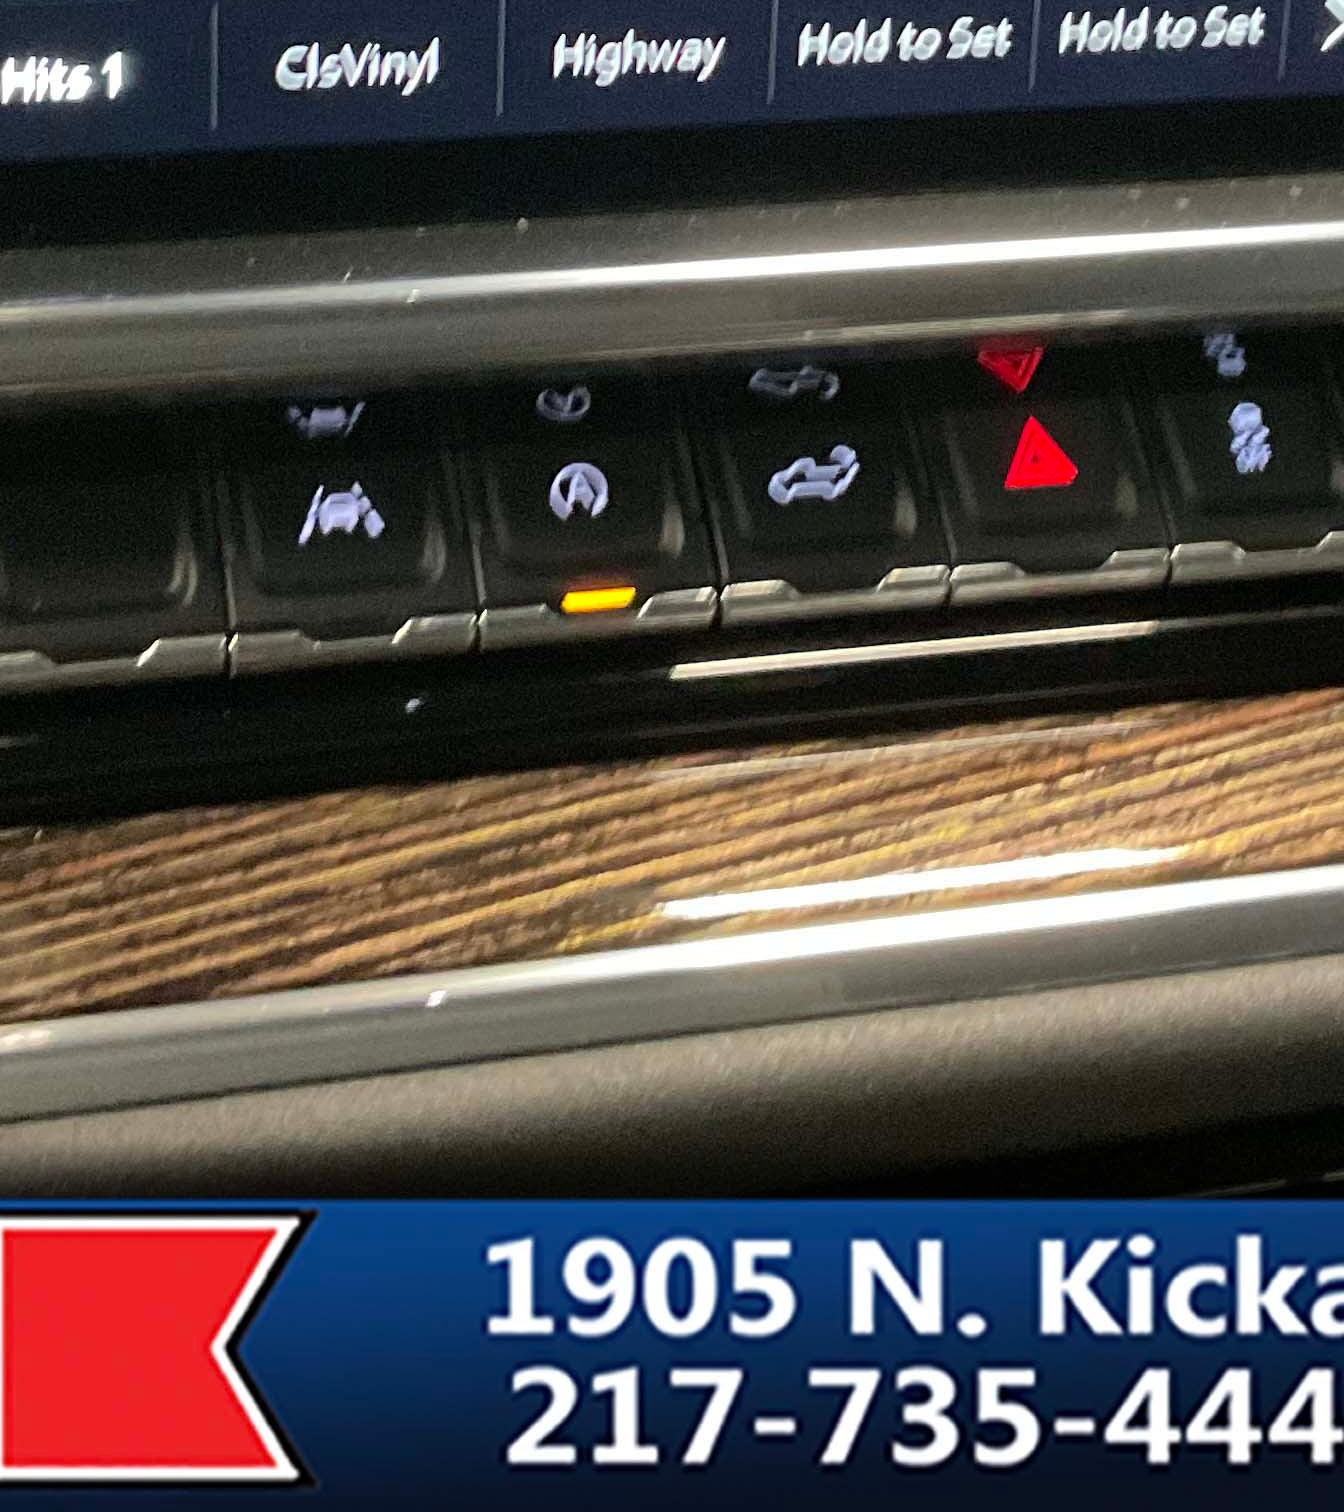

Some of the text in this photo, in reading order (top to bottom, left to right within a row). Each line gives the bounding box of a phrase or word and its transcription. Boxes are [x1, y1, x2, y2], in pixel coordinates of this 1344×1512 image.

[798, 17, 1012, 66] Hold to Set
[1059, 6, 1265, 54] Hold to Set
[0, 52, 128, 104] Hits 1
[276, 37, 439, 96] ClsVinyl
[554, 29, 726, 86] Highway
